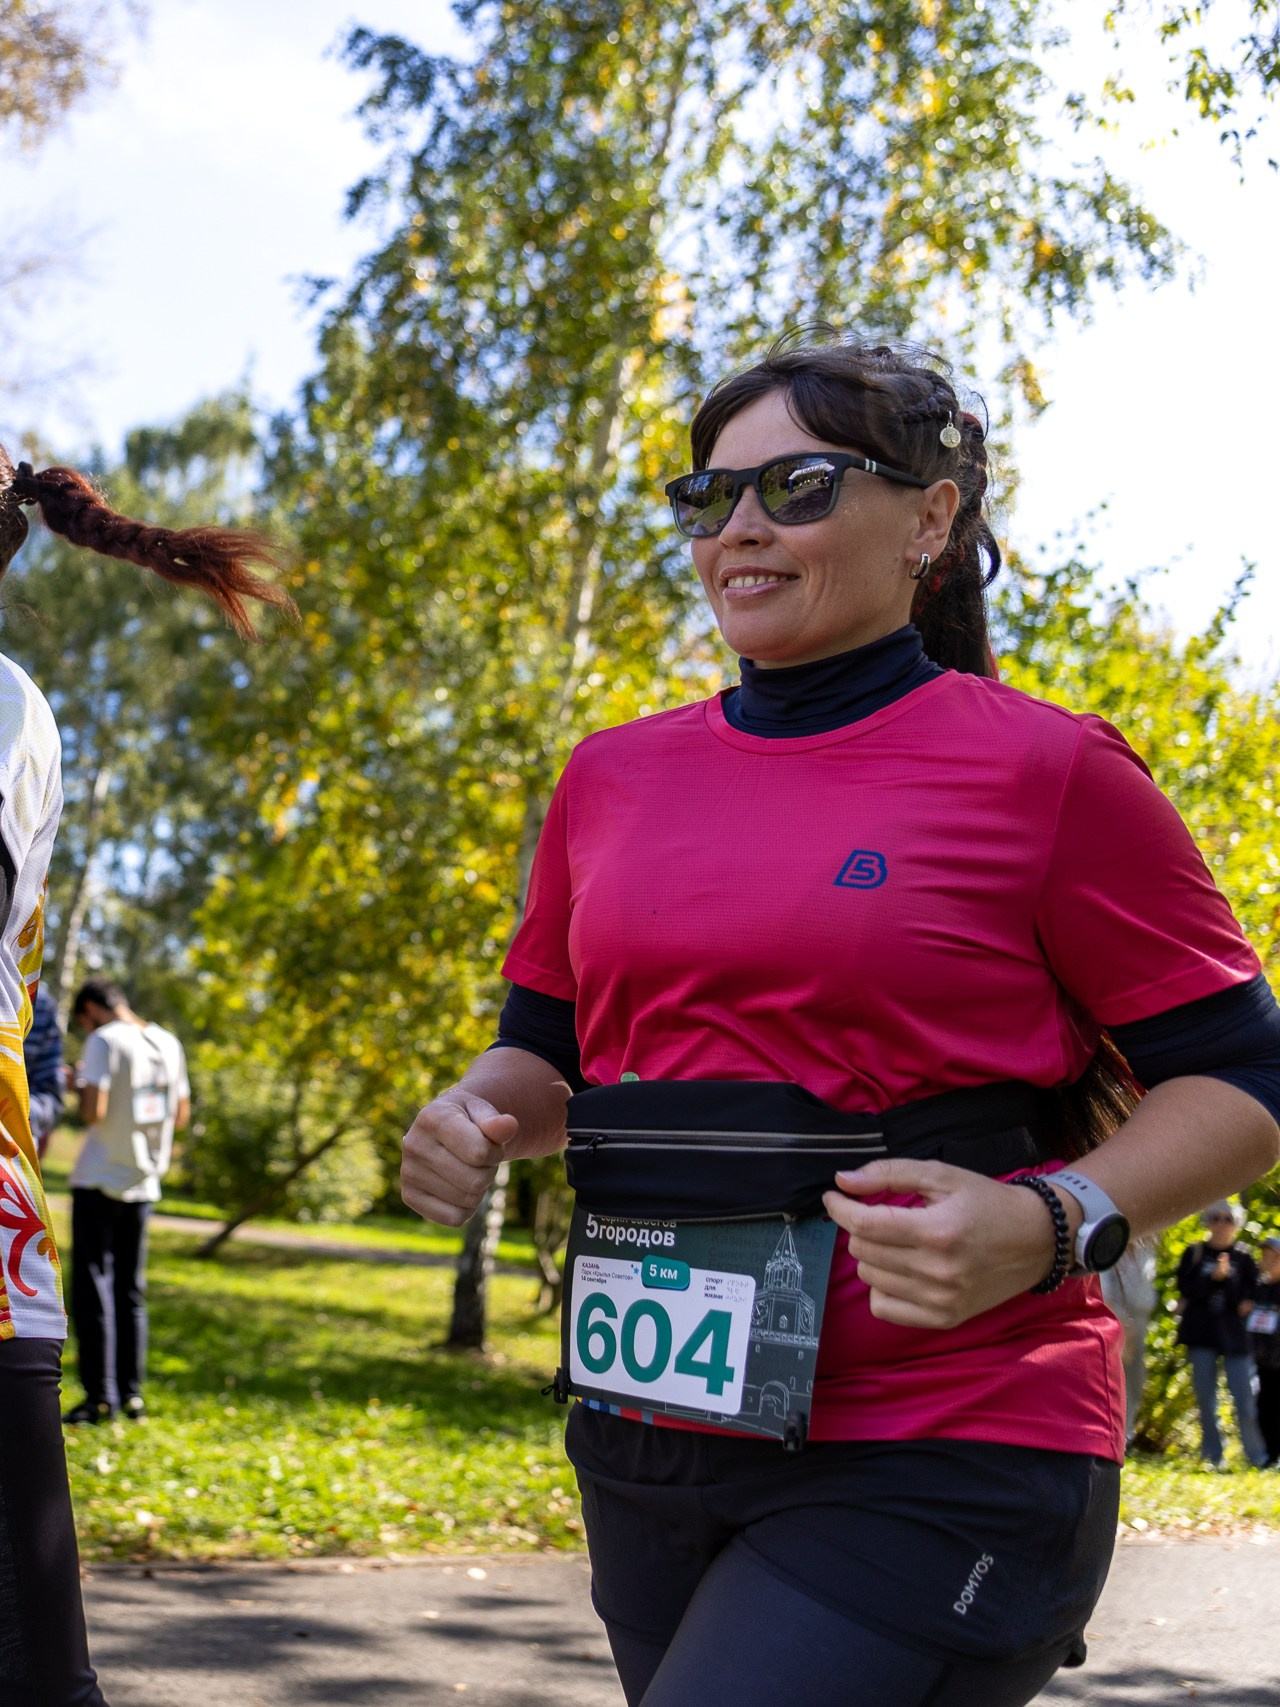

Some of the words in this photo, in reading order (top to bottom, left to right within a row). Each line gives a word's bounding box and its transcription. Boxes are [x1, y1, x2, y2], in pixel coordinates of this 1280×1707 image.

[581, 1261, 600, 1270] КАЗАНЬ
[649, 1263, 657, 1277] 5
[586, 1276, 607, 1284] сентября
[705, 1276, 724, 1285] спорт
[704, 1284, 716, 1292] для
[704, 1292, 724, 1300] жизни
[576, 1292, 735, 1397] 604
[953, 1552, 994, 1616] DOMYOS
